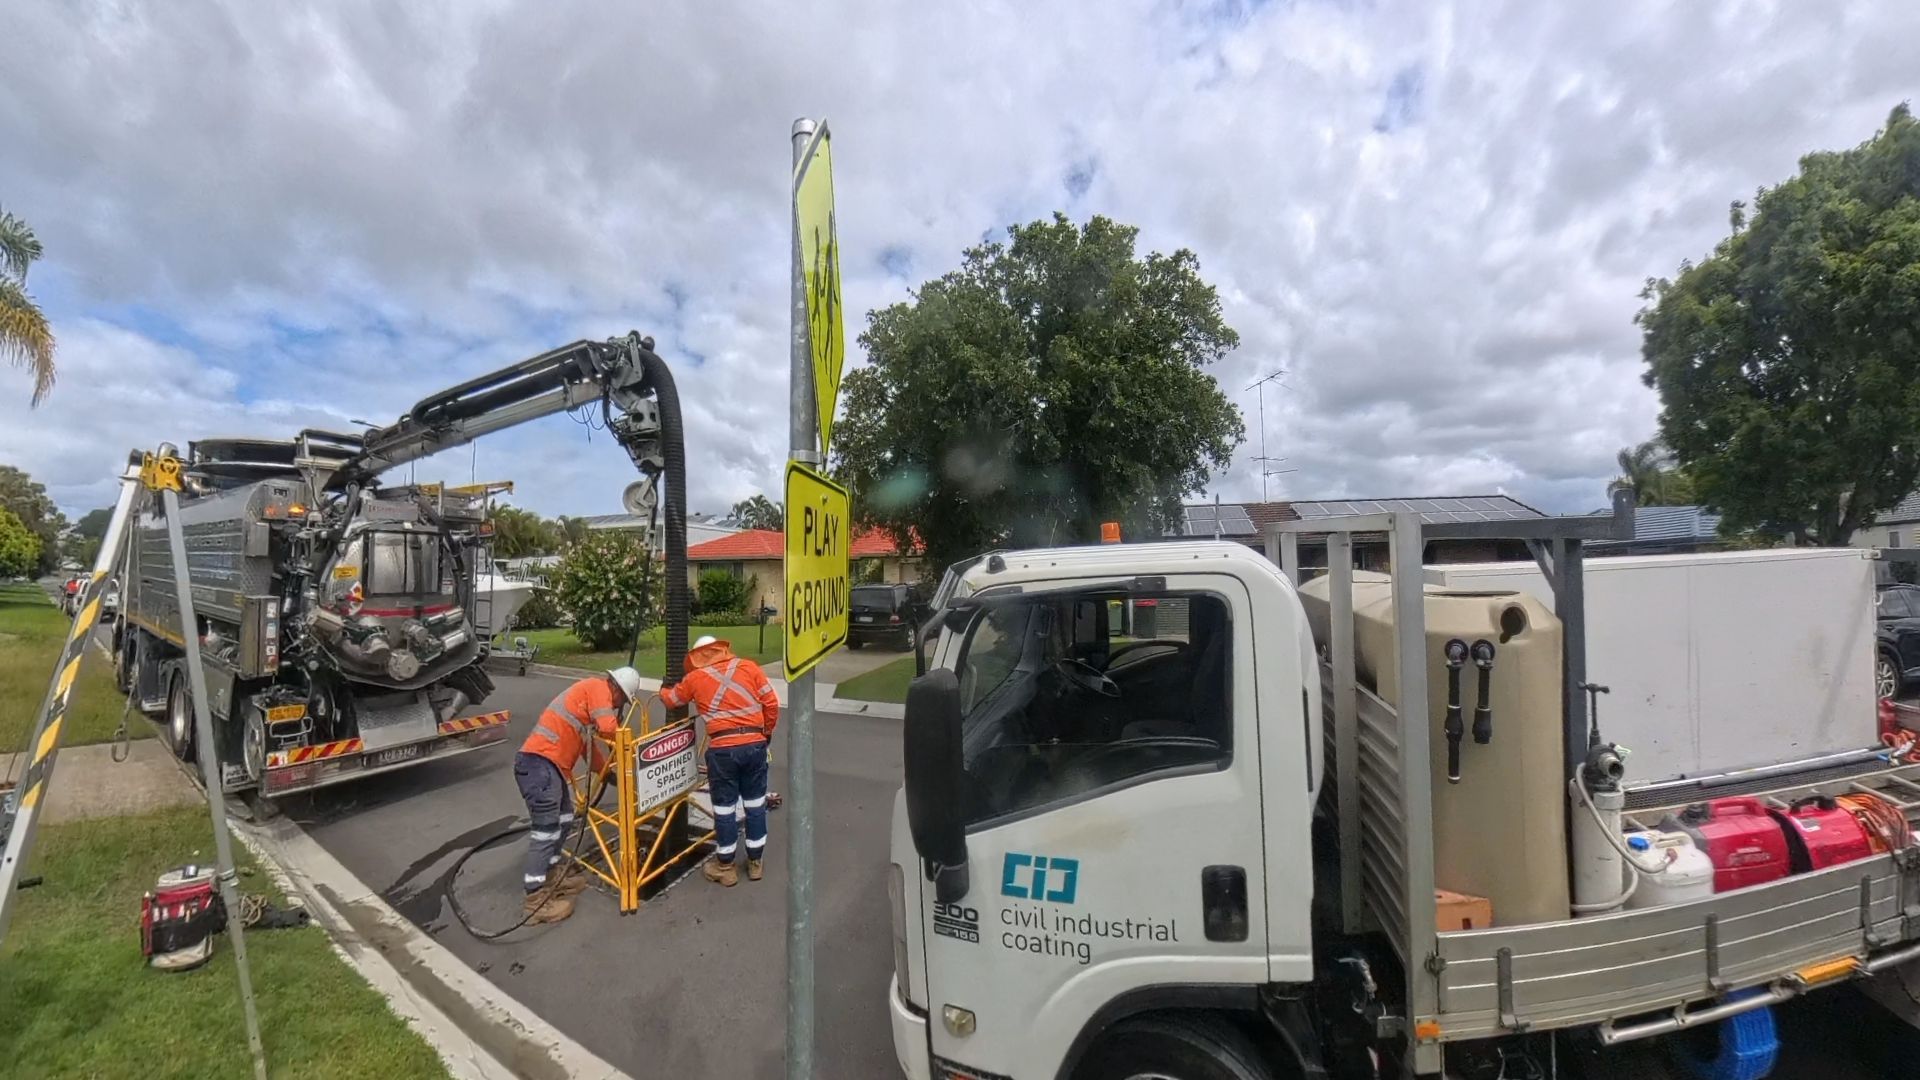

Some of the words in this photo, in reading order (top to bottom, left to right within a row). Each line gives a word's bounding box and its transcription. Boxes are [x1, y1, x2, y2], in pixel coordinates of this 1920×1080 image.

[804, 506, 838, 557] PLAY
[791, 576, 845, 637] GROUND
[649, 733, 689, 759] DANGER
[646, 752, 692, 780] CONFINED
[657, 767, 687, 788] SPACE
[933, 900, 978, 922] 300
[1001, 904, 1047, 931] civil
[1055, 909, 1179, 942] industrial
[1002, 931, 1091, 965] coating
